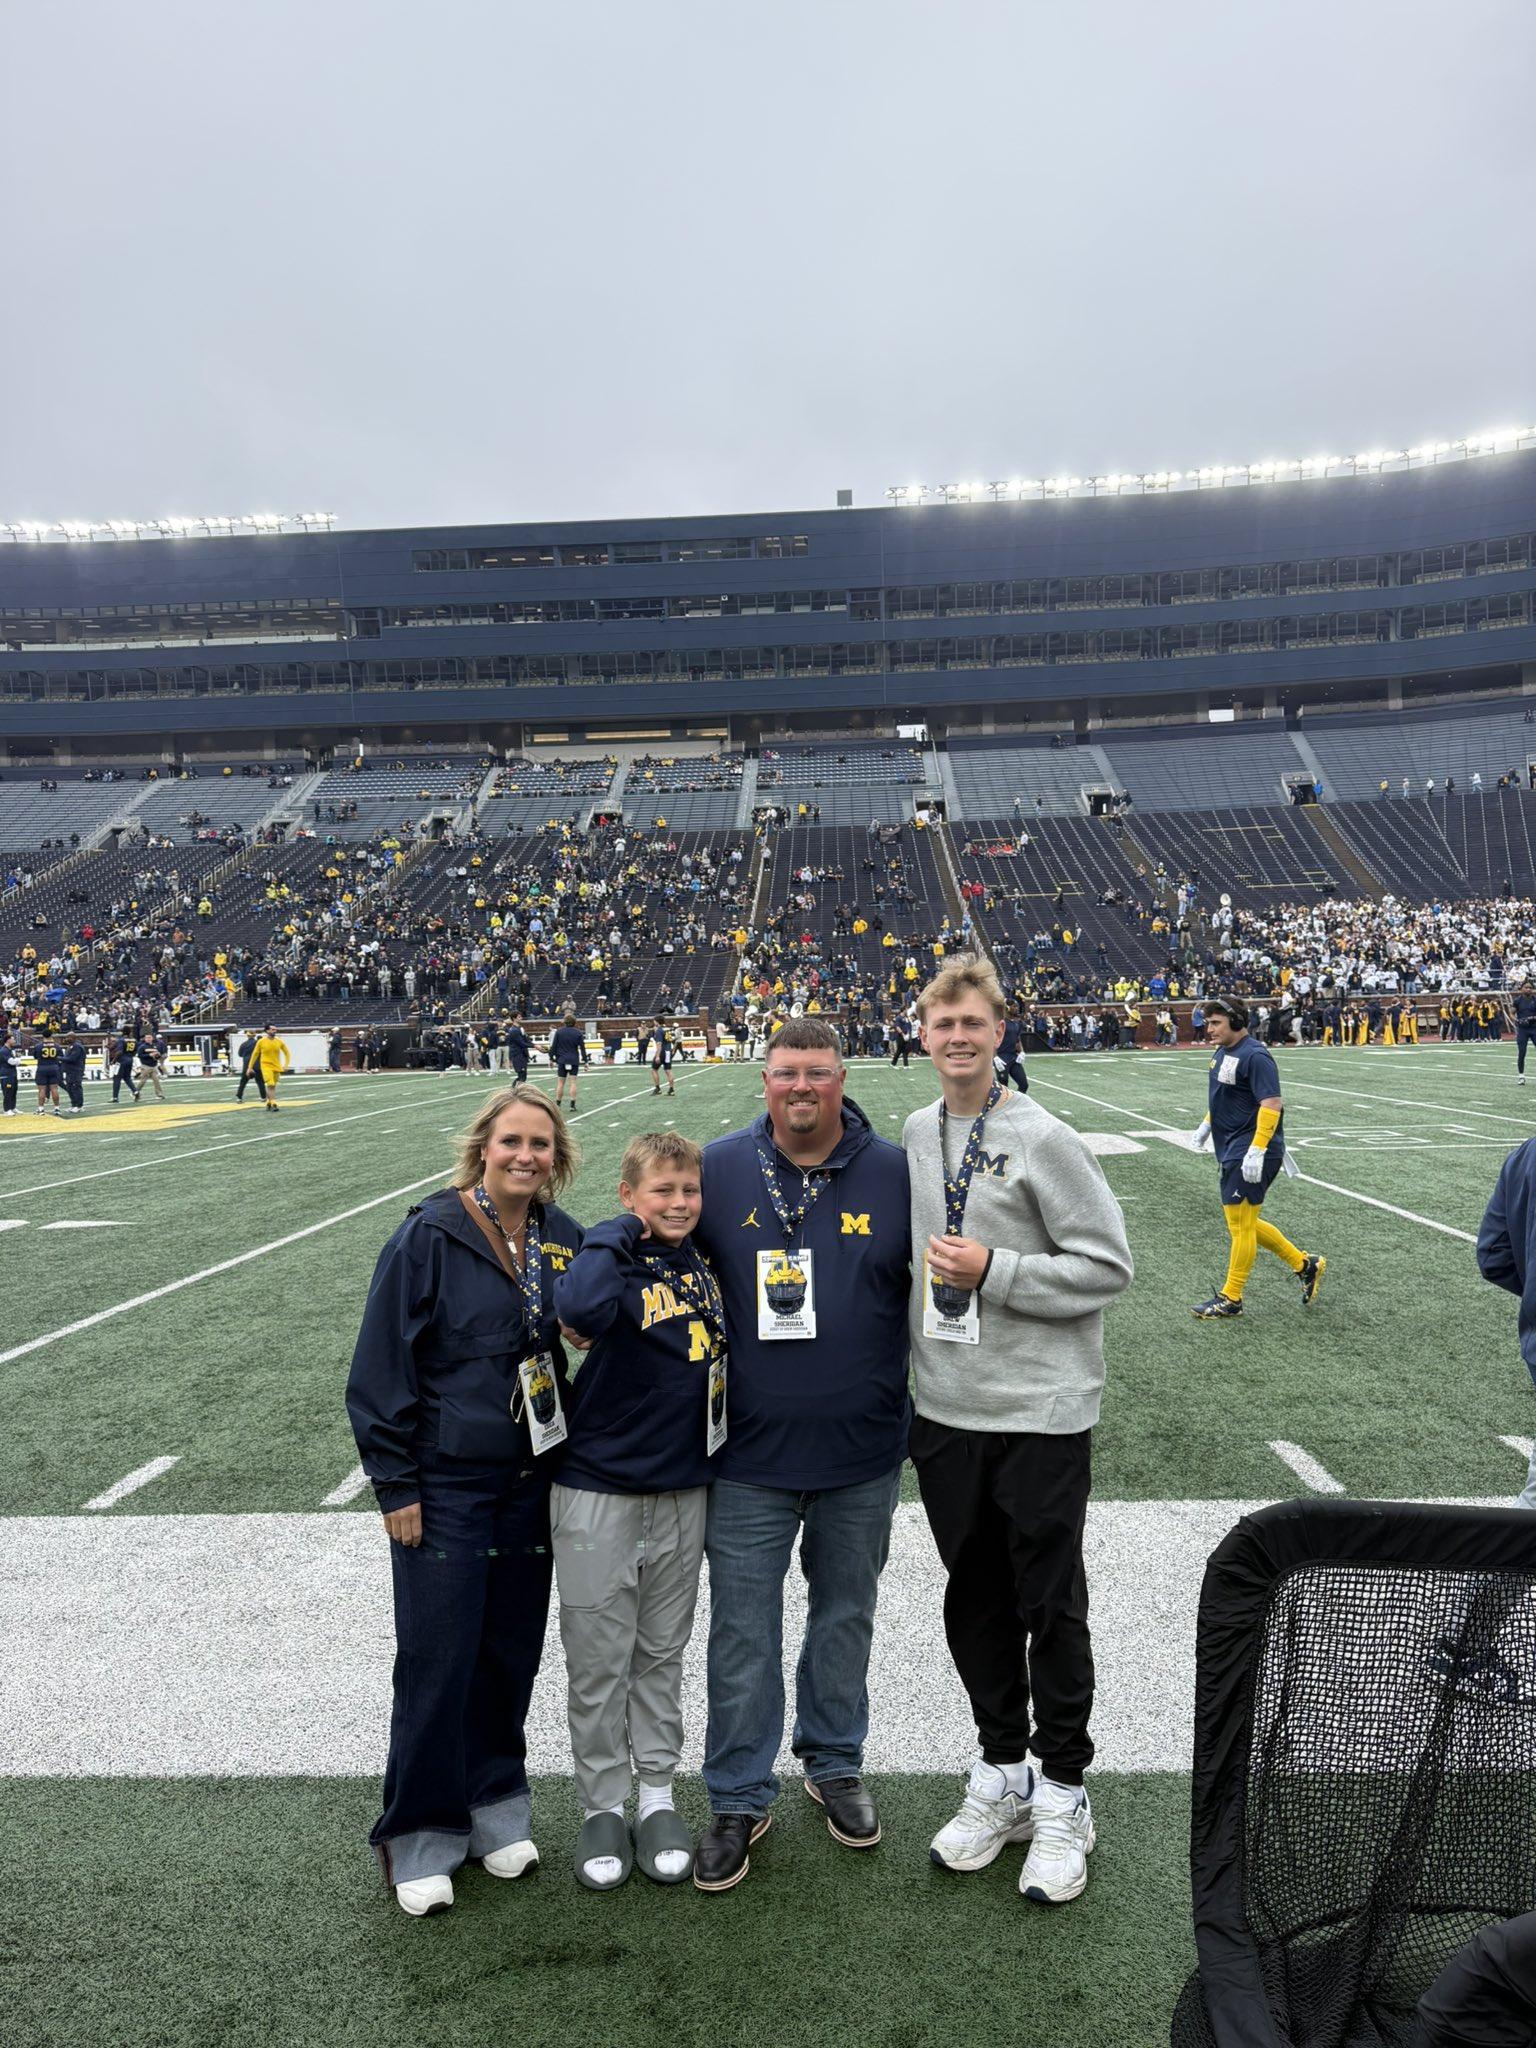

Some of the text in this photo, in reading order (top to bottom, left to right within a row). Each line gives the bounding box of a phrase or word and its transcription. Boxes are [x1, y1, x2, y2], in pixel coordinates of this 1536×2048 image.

[42, 1047, 57, 1058] 30
[173, 1066, 184, 1074] M
[974, 1150, 1010, 1180] M
[841, 1212, 870, 1235] M
[551, 1255, 567, 1271] M
